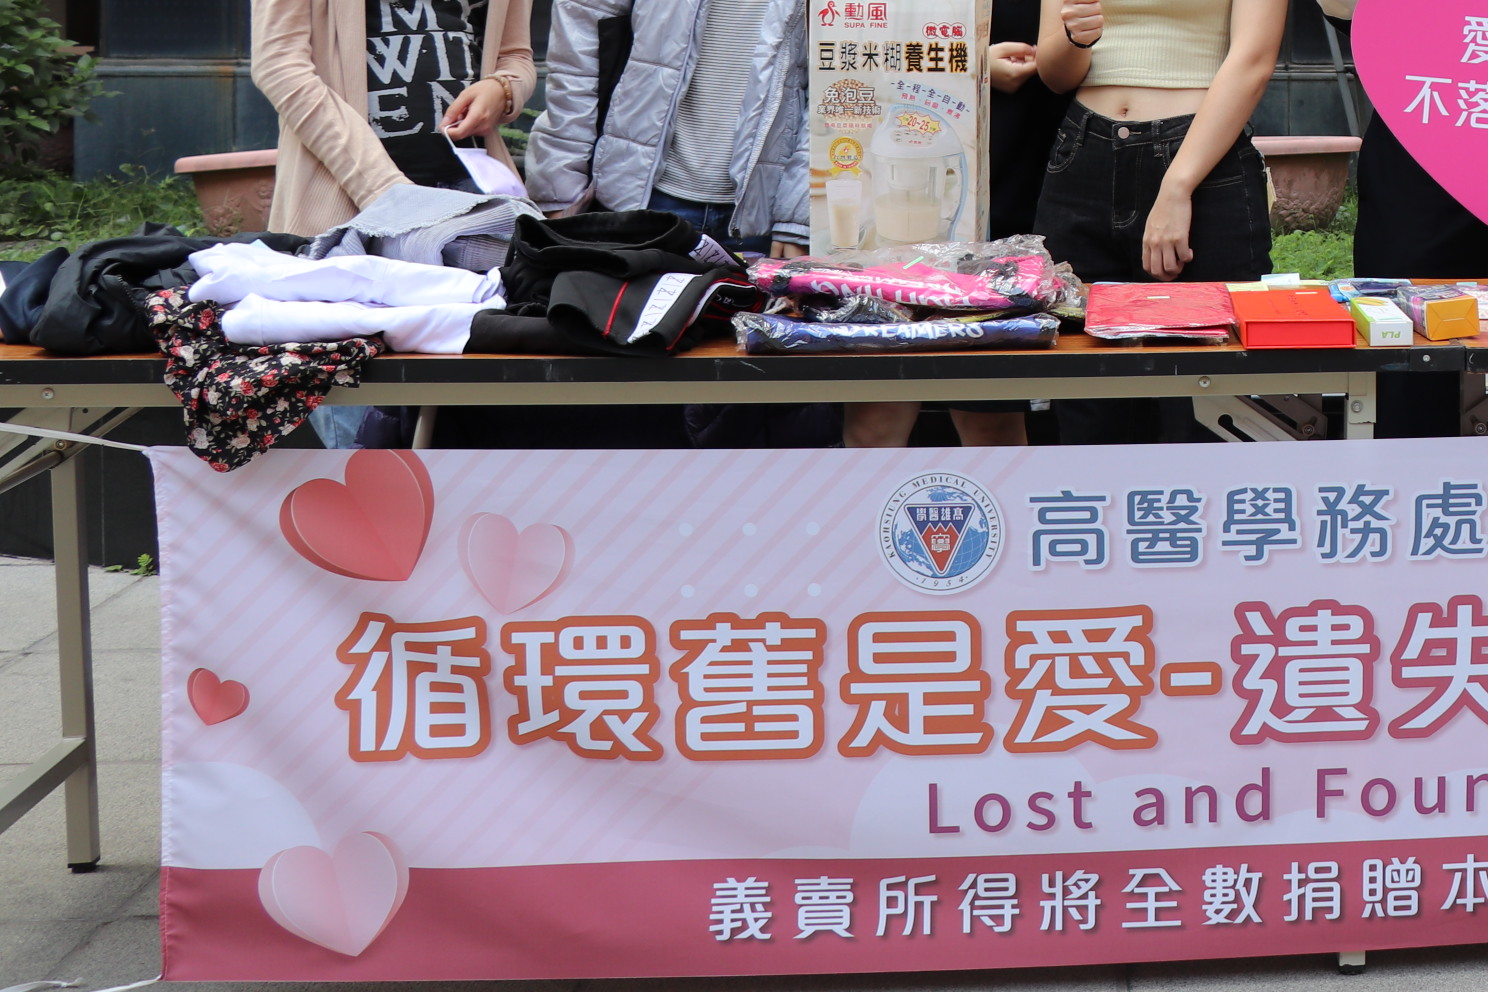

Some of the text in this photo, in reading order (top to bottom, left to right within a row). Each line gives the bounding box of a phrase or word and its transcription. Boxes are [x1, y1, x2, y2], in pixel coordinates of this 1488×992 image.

[818, 42, 968, 73] 豆漿米糊養生機
[824, 87, 876, 104] 免泡豆
[1381, 330, 1401, 340] PLA
[882, 476, 998, 559] KAOHSIUNG MEDICAL UNIVERSITY
[929, 780, 1093, 834] Lost
[1133, 767, 1271, 826] and
